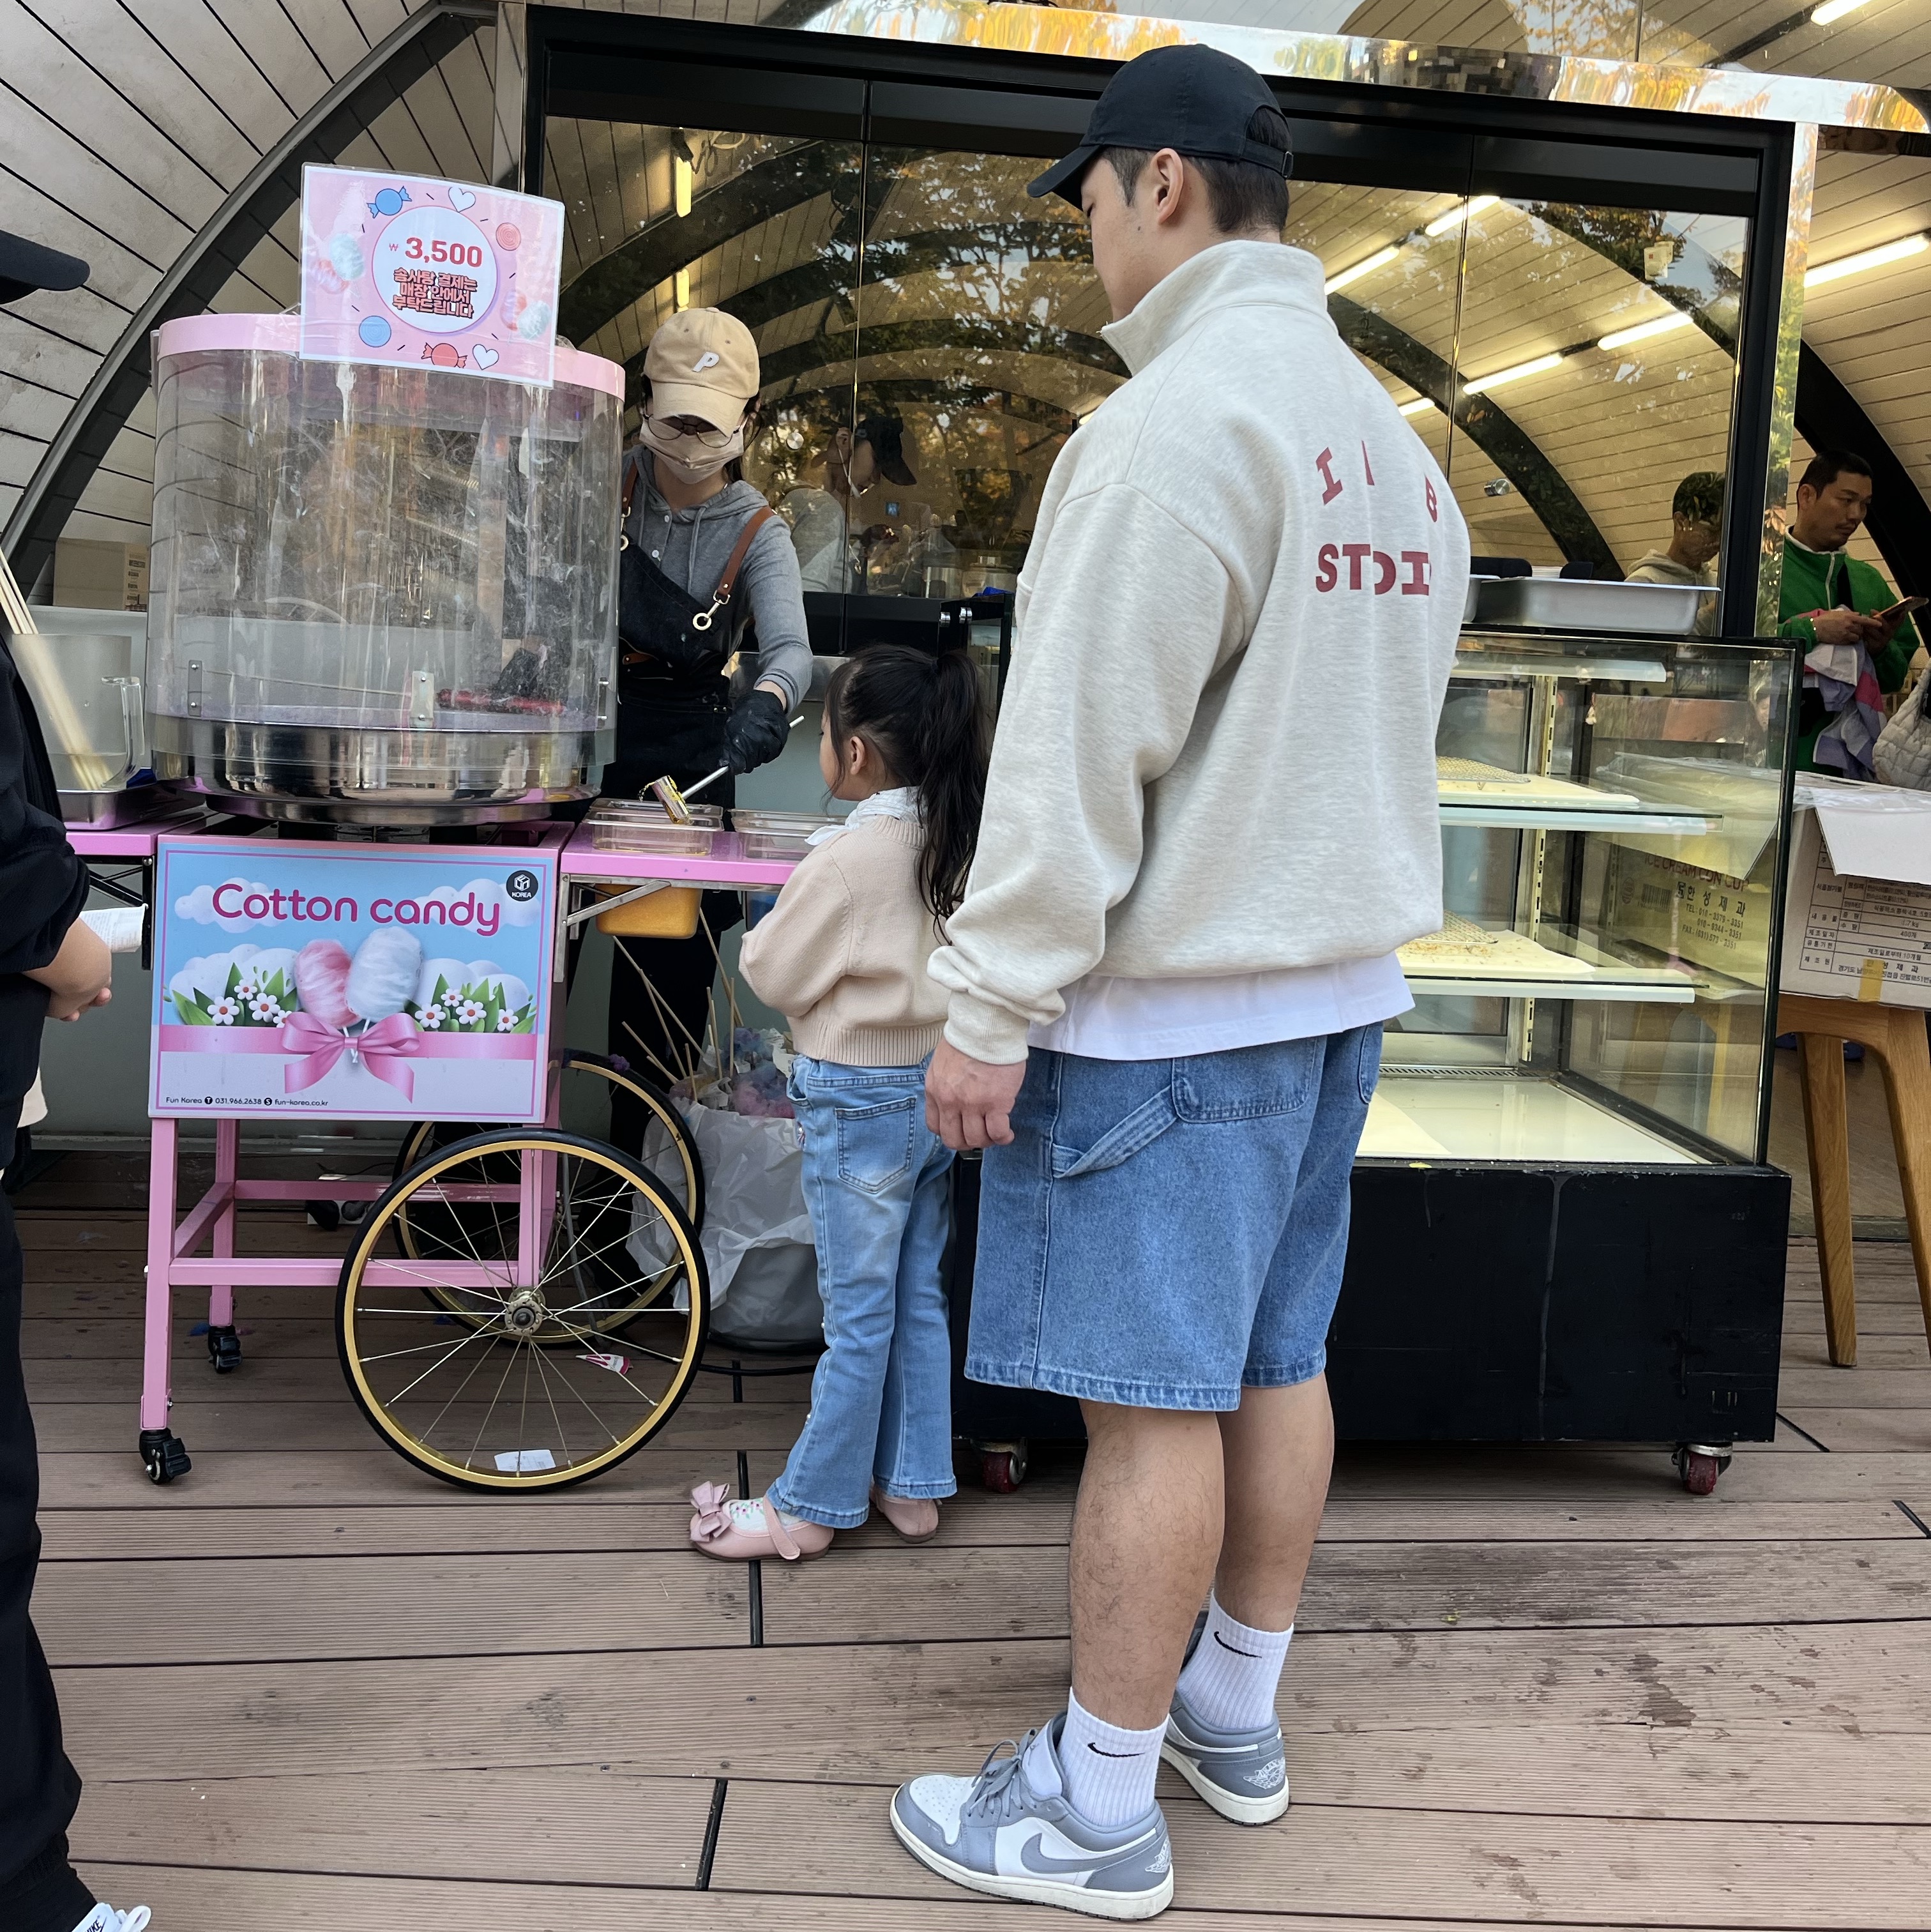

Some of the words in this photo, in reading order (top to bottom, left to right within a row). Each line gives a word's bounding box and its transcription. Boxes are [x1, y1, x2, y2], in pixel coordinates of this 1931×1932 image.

[405, 237, 483, 268] 3,500
[393, 267, 437, 286] 솜사탕
[437, 272, 478, 293] 결제는
[400, 282, 429, 299] 매장
[430, 285, 471, 304] 안에서
[392, 294, 474, 319] 부탁드립니다
[692, 352, 720, 372] P
[213, 883, 358, 922] Cotton
[370, 892, 500, 936] candy
